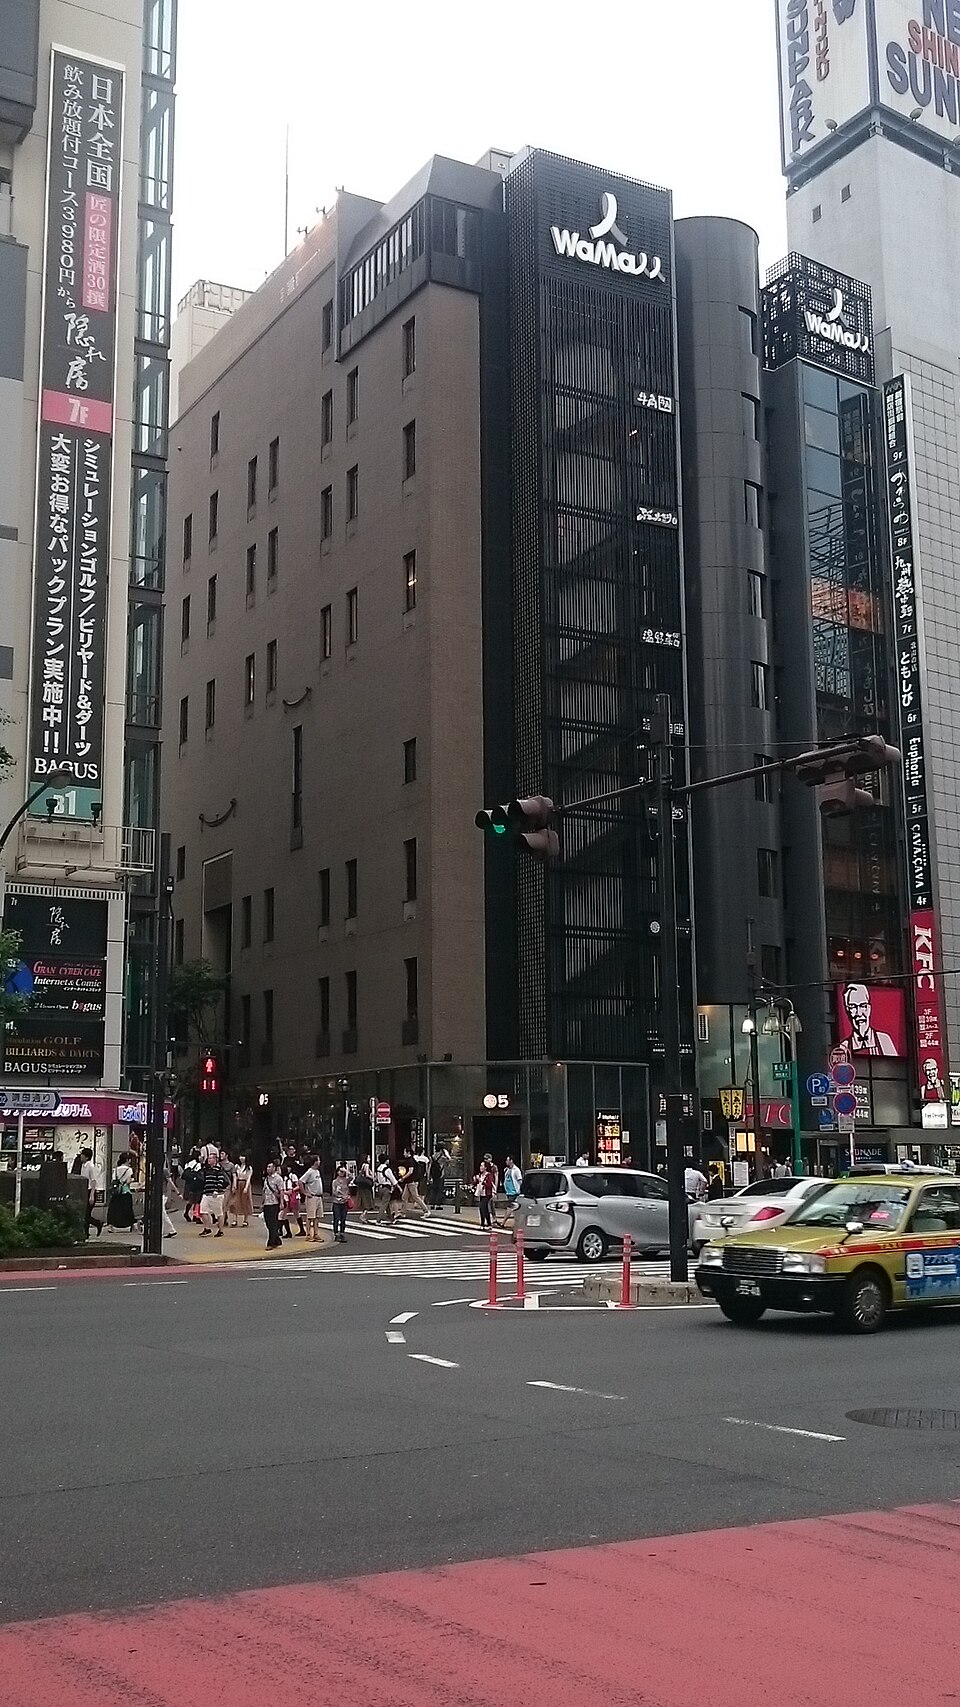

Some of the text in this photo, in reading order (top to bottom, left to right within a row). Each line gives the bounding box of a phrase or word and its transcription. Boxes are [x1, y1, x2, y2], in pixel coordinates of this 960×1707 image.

[886, 41, 960, 125] SUN
[87, 75, 115, 193] 日本全国
[69, 398, 89, 427] 7F
[893, 451, 904, 462] 9F
[897, 537, 908, 547] 8F
[902, 624, 913, 634] 7F
[900, 651, 914, 707] ともしび
[907, 713, 918, 723] 6F
[907, 736, 923, 787] Euphoria
[34, 757, 99, 780] BAGUS
[911, 803, 923, 814] 5F
[916, 895, 927, 906] 4F
[914, 924, 936, 990] KFC
[43, 1036, 82, 1046] GOLF
[5, 1046, 58, 1057] BILLIARDS
[69, 1049, 101, 1059] DARTS
[4, 1061, 48, 1074] BAGUS
